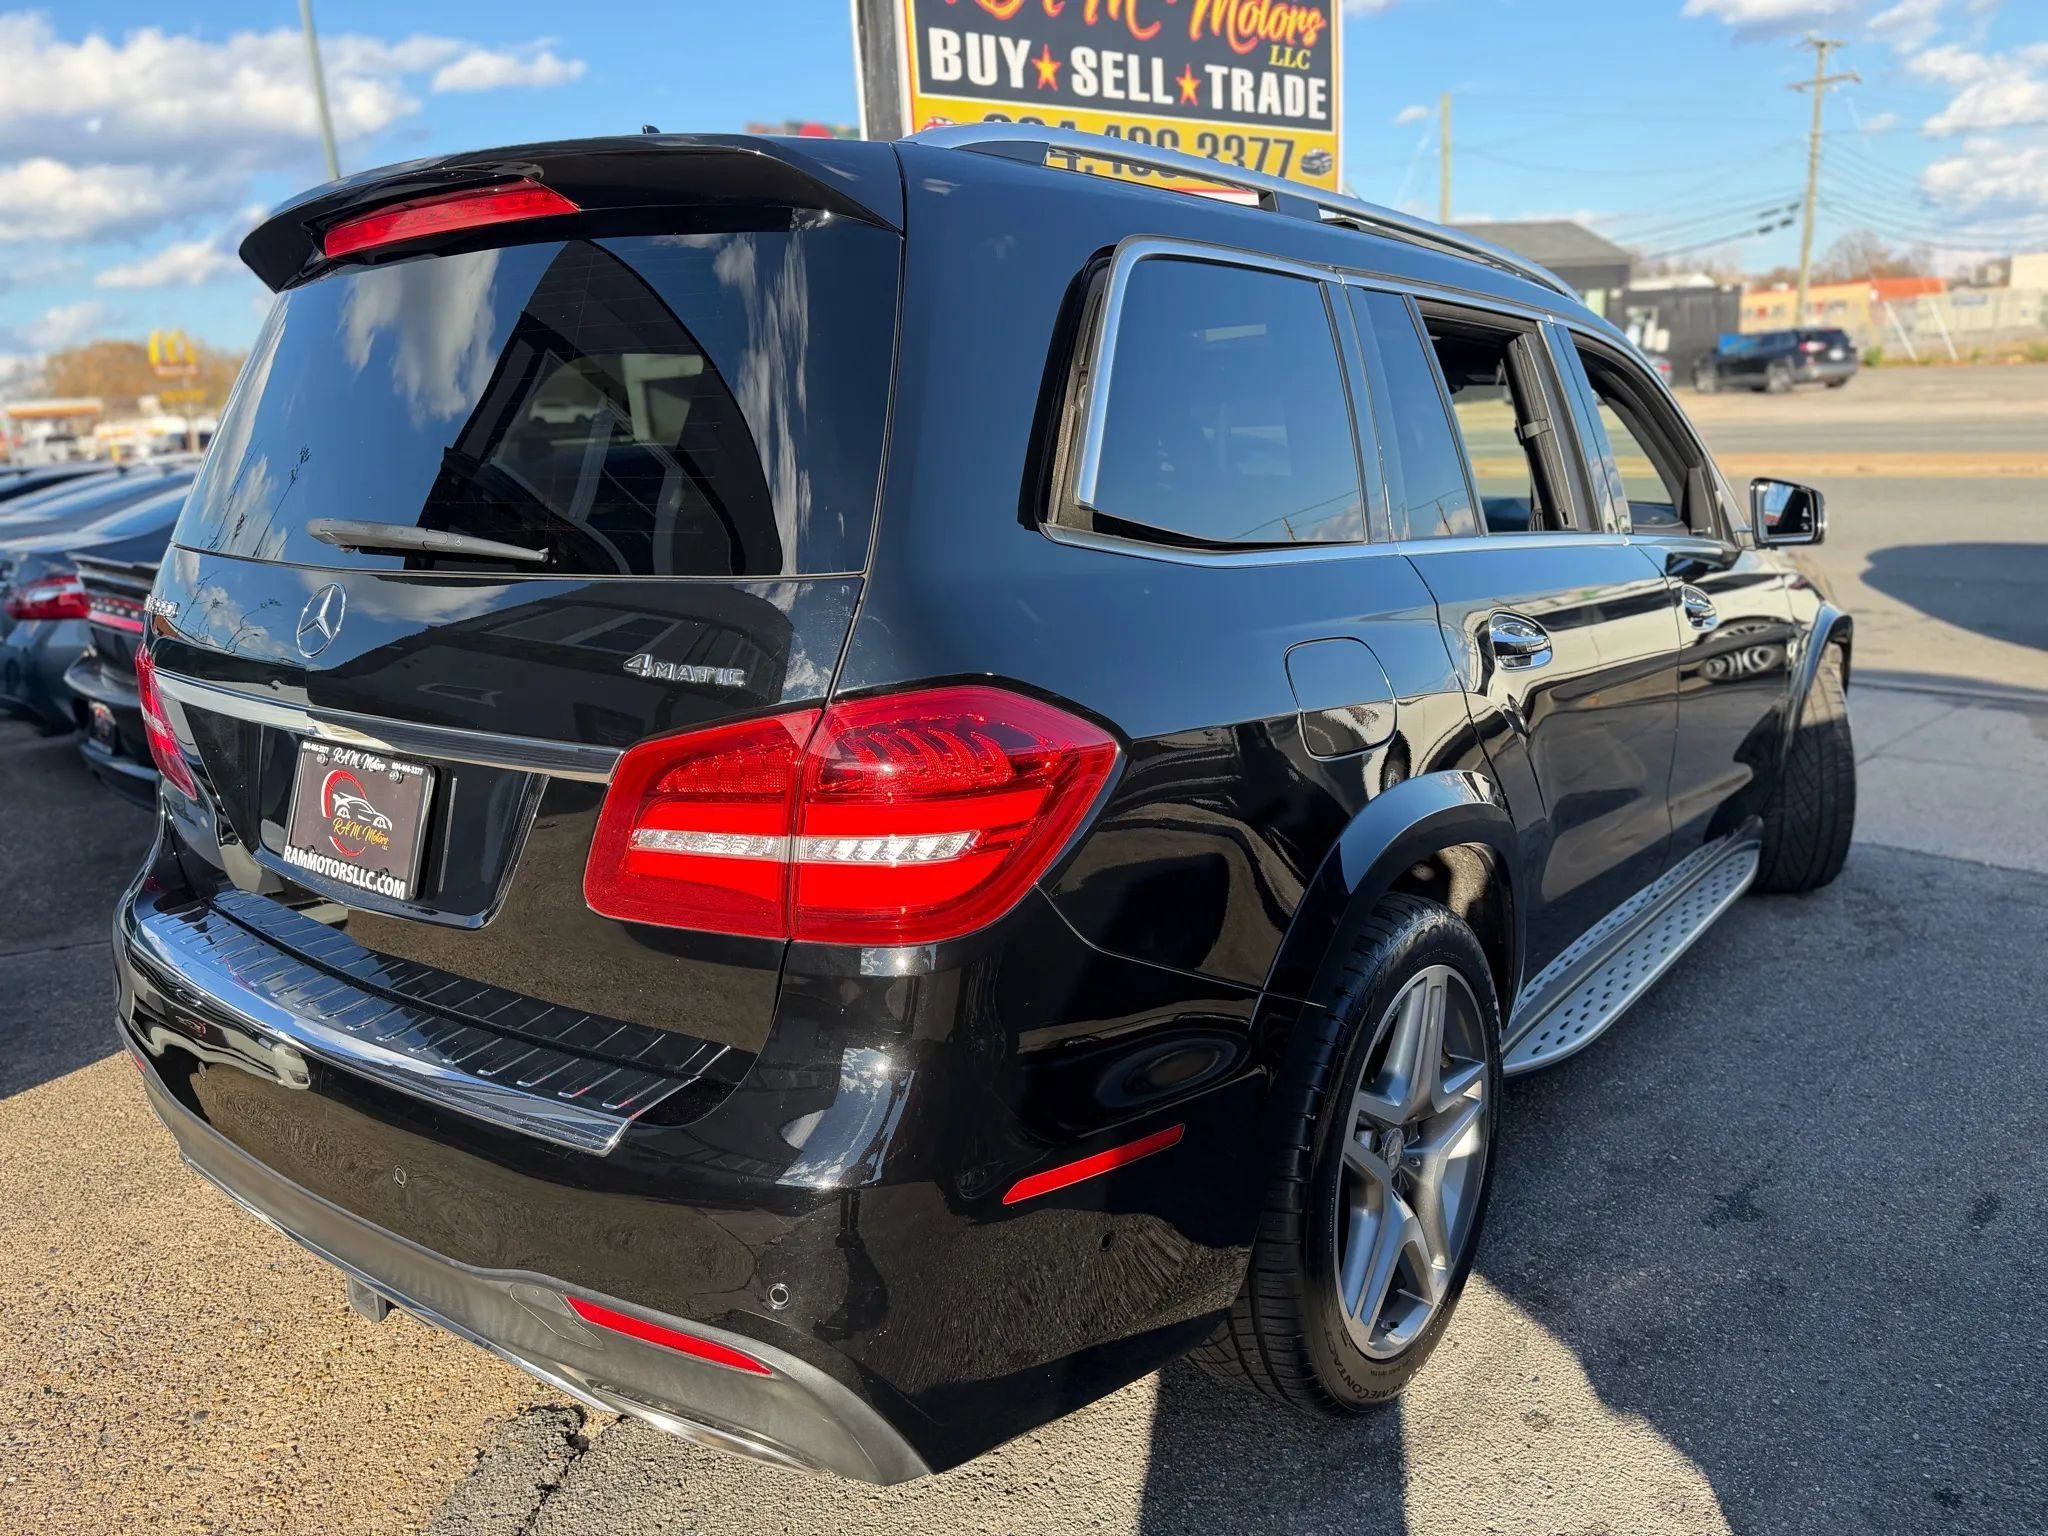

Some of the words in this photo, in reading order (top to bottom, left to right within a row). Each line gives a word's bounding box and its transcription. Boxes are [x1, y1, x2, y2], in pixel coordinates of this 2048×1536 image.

[928, 27, 1032, 89] BUY
[1070, 45, 1173, 104] SELL
[1204, 64, 1327, 120] TRADE
[1268, 45, 1311, 70] LLC
[623, 653, 746, 687] 4MATIC
[283, 845, 406, 900] RAMMOTORSLLC.COM
